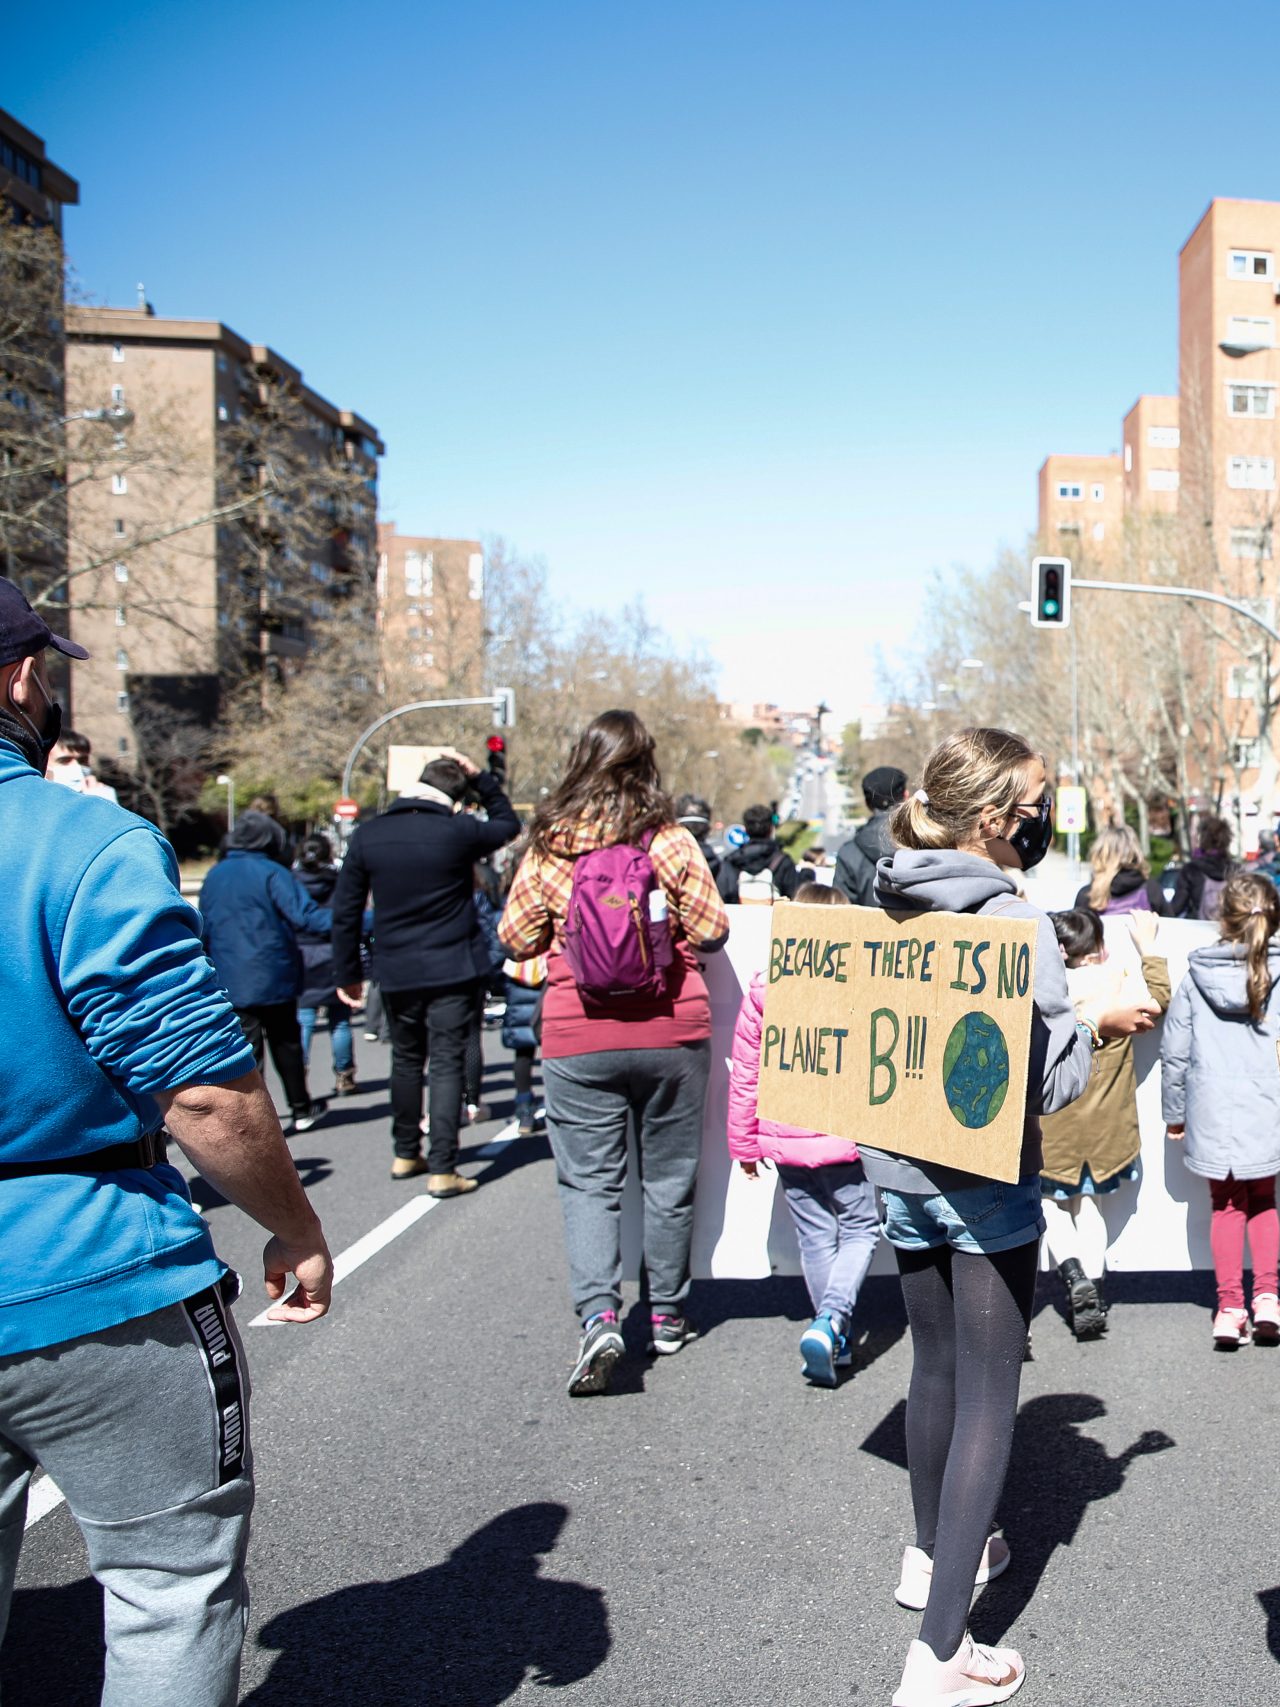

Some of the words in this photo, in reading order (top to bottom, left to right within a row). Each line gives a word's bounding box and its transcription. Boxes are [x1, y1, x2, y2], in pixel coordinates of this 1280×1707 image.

[769, 938, 851, 984] BECAUSE
[864, 938, 936, 982] THERE
[950, 940, 990, 995] IS
[997, 942, 1030, 999] NO
[764, 1025, 849, 1076] PLANET
[194, 1303, 232, 1368] PUMA
[223, 1400, 241, 1467] PUMA
